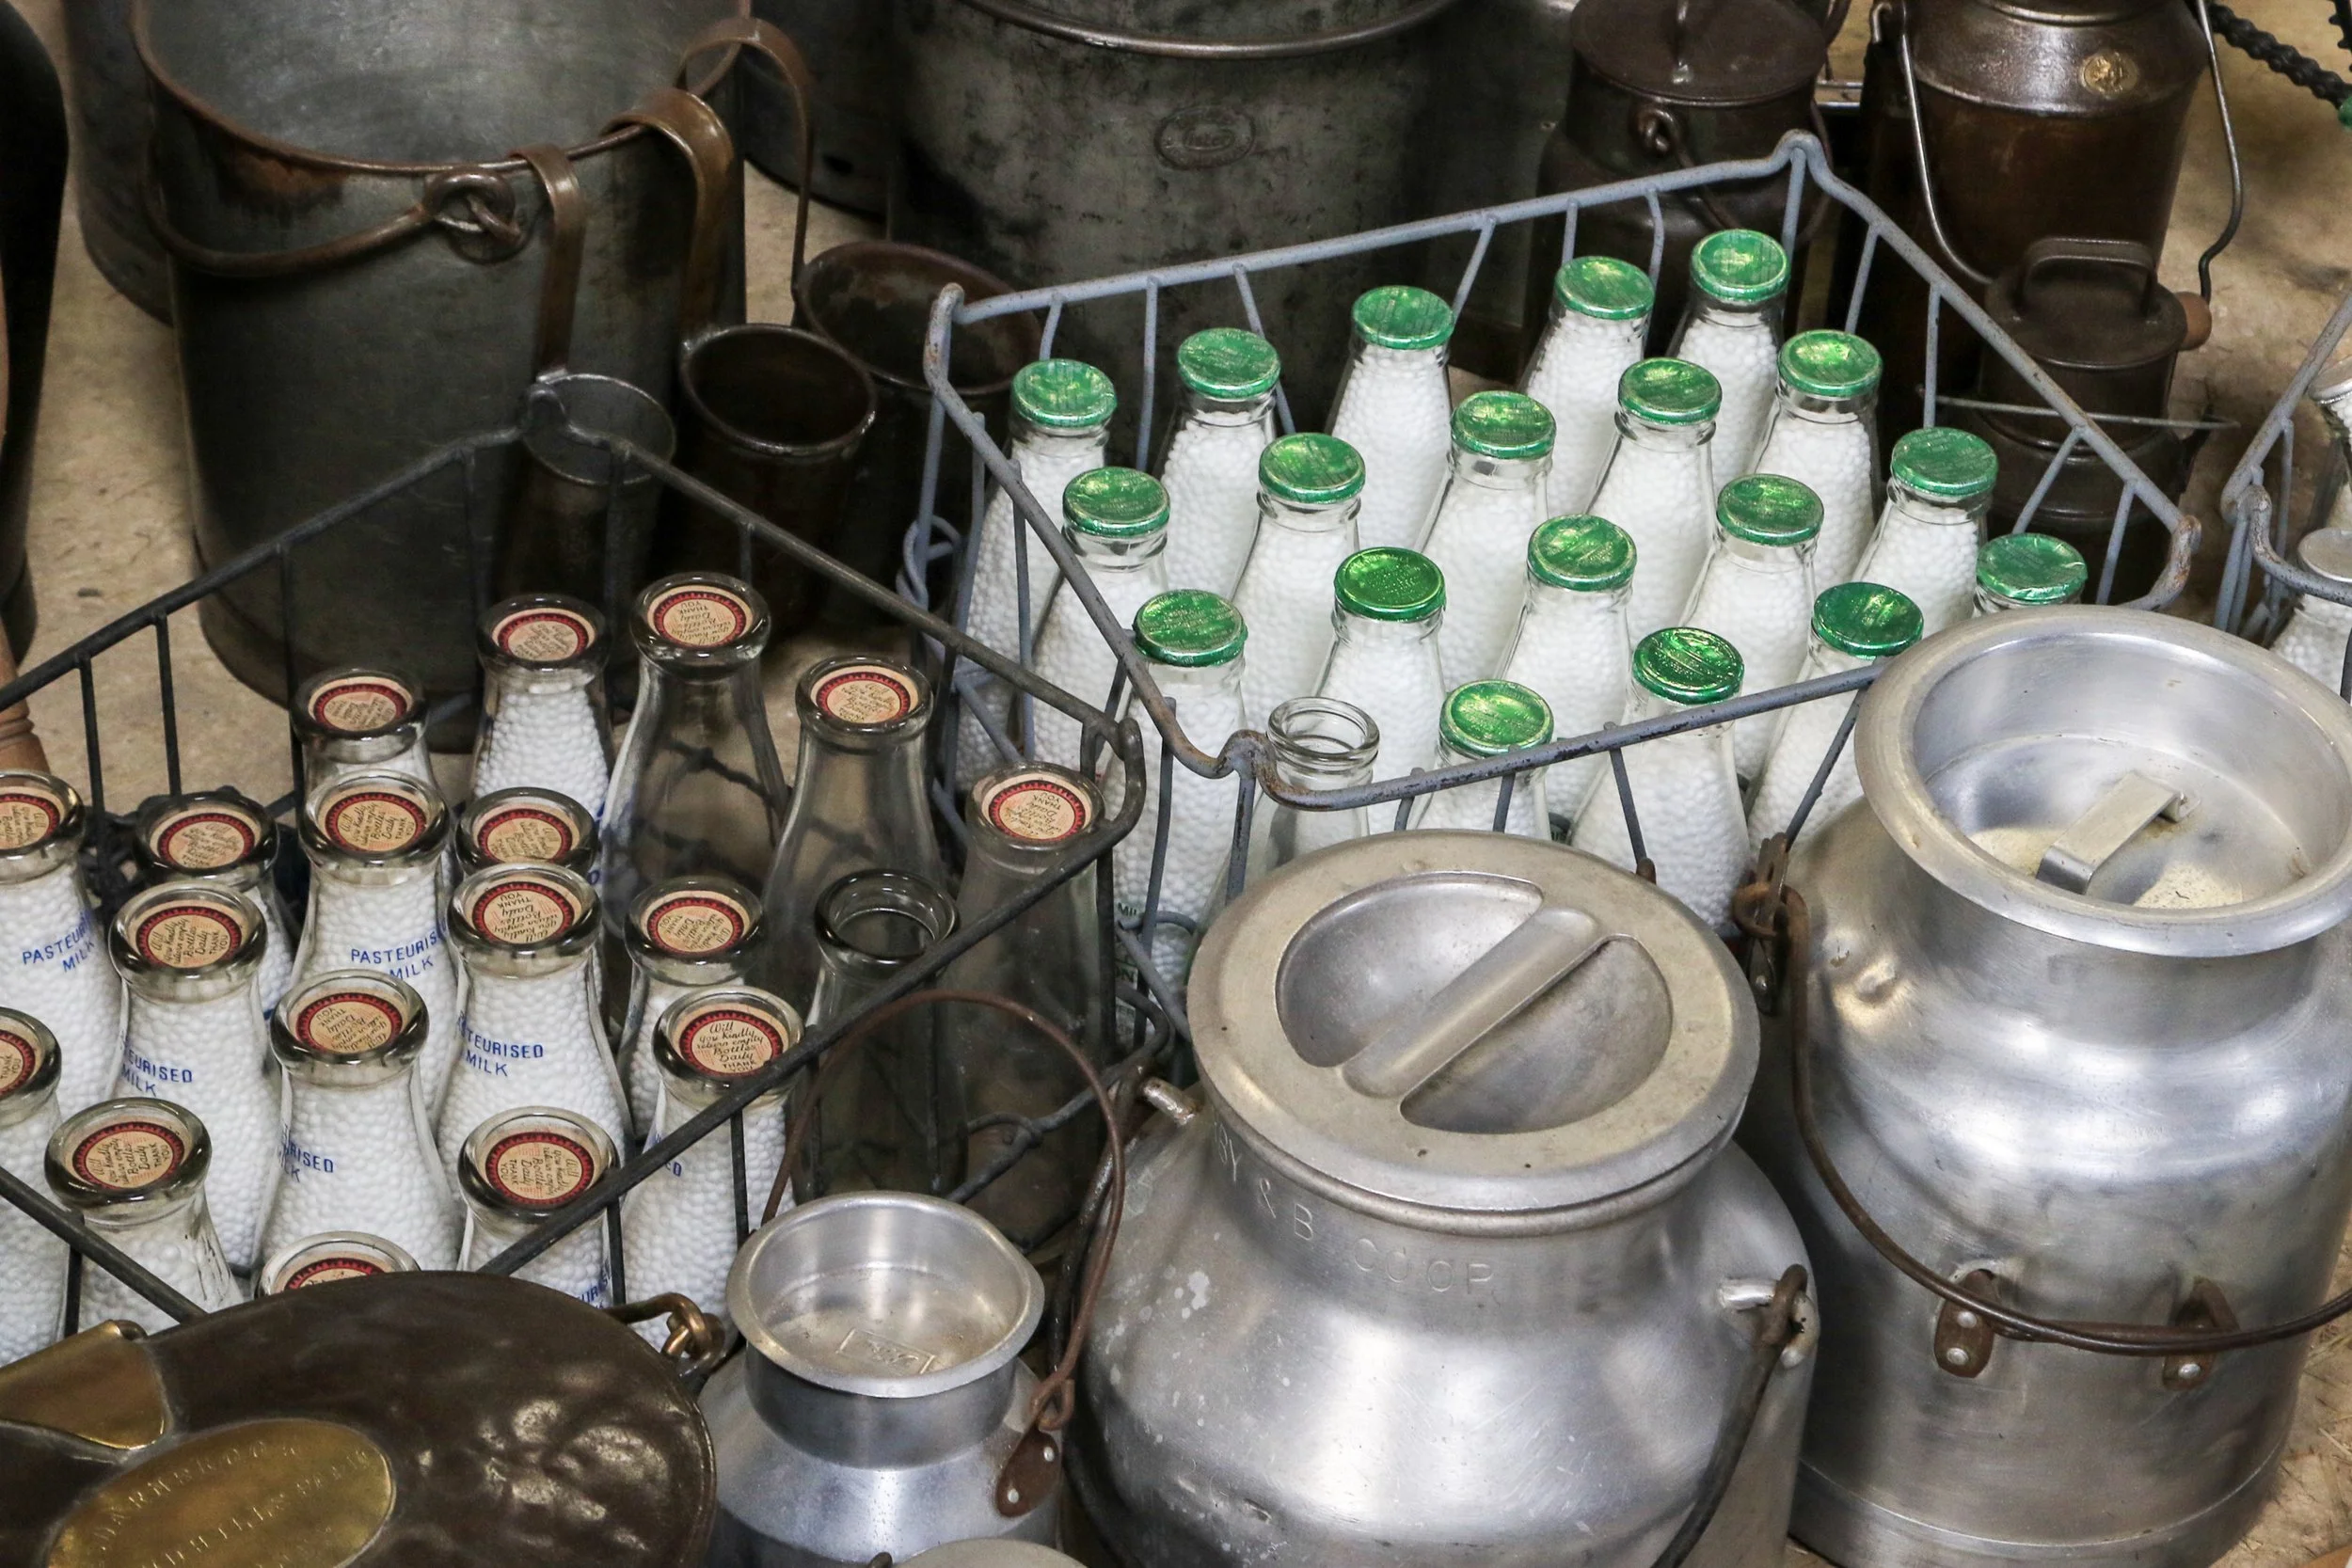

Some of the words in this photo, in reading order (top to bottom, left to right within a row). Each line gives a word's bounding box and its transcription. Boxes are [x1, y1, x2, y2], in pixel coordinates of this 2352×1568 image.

[23, 910, 91, 965] PASTEUR
[351, 927, 442, 964] PASTEURIS
[62, 939, 95, 973] MILK
[389, 956, 434, 980] MILK
[459, 1019, 544, 1059] TEURISED
[709, 1021, 734, 1034] Will
[732, 1037, 763, 1046] empty
[466, 1049, 508, 1077] MILK
[713, 1044, 755, 1054] Bottles
[720, 1053, 754, 1062] Daily
[723, 1059, 756, 1069] THANK
[121, 1063, 157, 1098] MILK
[1294, 1202, 1314, 1241] B
